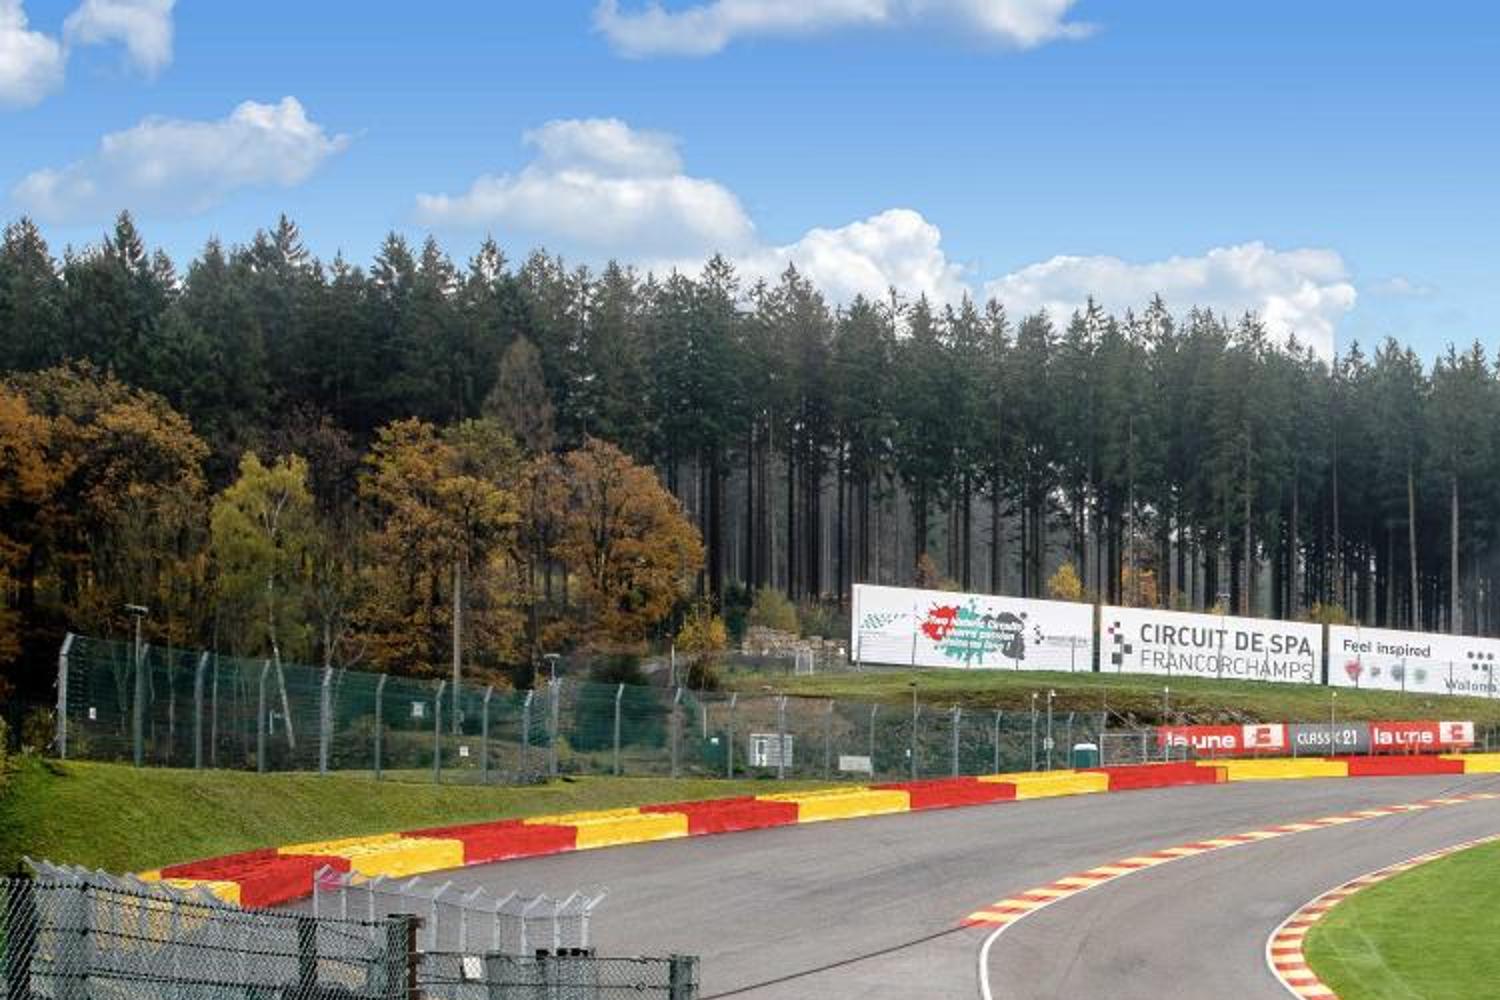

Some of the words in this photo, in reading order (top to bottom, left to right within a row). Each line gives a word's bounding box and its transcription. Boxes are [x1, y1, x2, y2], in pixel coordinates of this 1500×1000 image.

[1140, 623, 1228, 649] CIRCUIT
[1235, 631, 1264, 653] DE
[1270, 634, 1312, 657] SPA
[1343, 639, 1371, 653] Feel
[1377, 641, 1431, 659] inspired
[1140, 649, 1313, 681] FRANCORCHAMPS
[1167, 731, 1187, 747] la
[1192, 734, 1236, 749] une
[1297, 730, 1341, 746] CLASSC
[1343, 729, 1357, 746] 21
[1373, 727, 1393, 745] la
[1395, 730, 1433, 745] une
